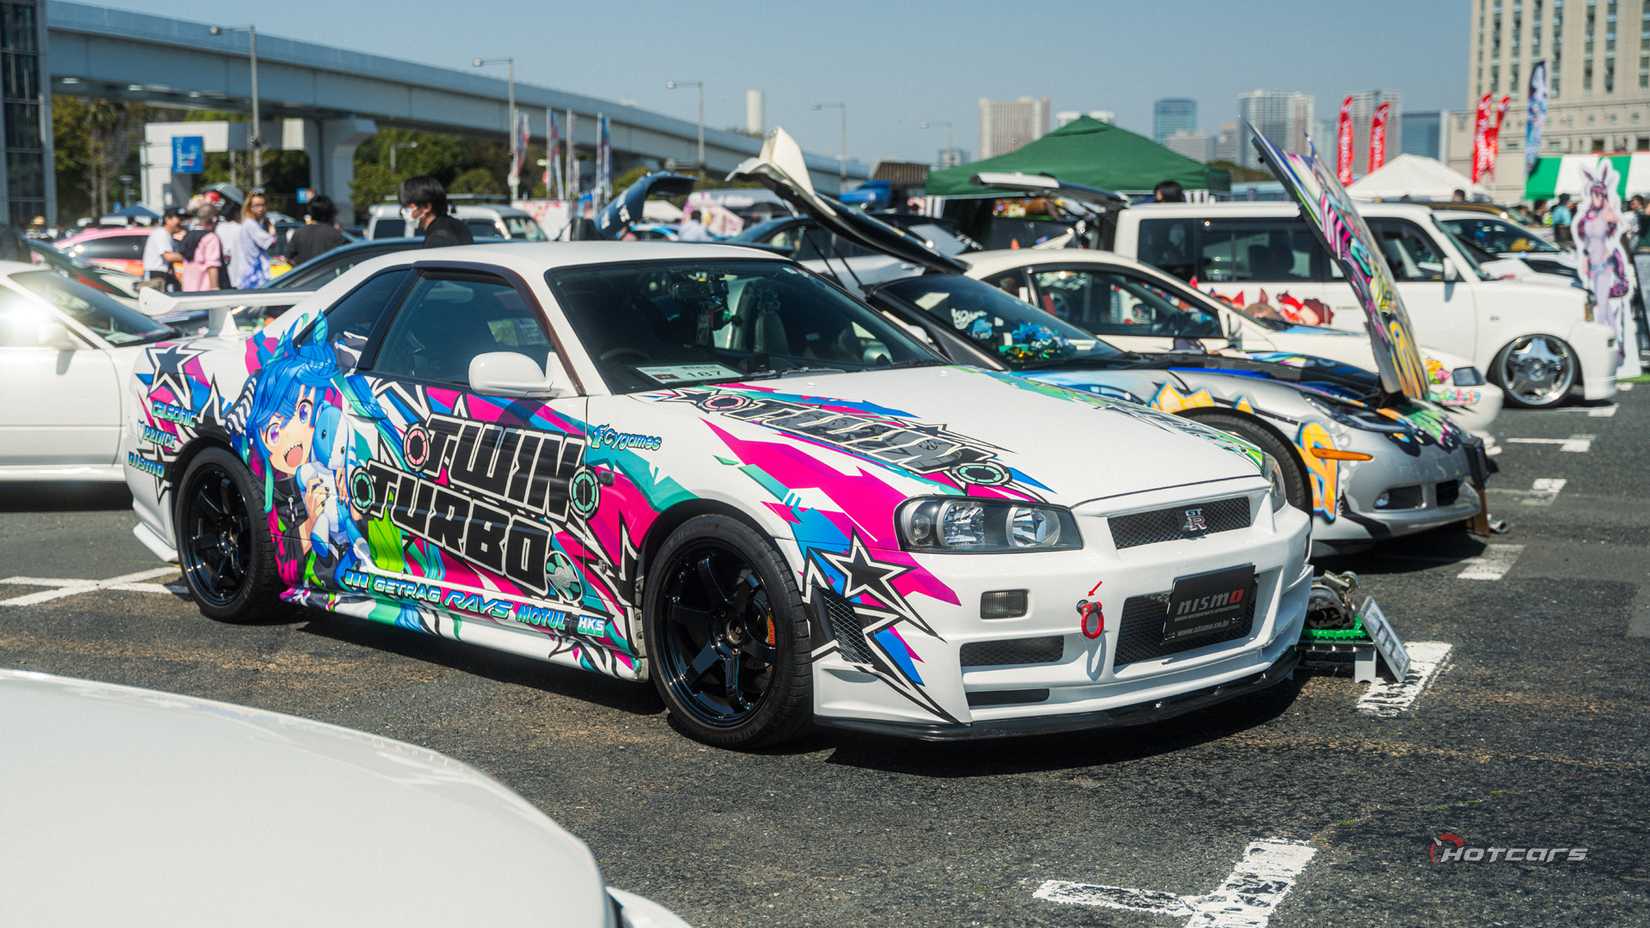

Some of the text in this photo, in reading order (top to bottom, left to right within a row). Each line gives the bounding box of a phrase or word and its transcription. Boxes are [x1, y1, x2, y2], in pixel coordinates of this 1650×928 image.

[425, 413, 587, 522] TWIN
[604, 428, 662, 451] Cygames
[366, 459, 552, 596] TURBO
[374, 577, 606, 637] GETRAG RAYS MOTUL HKS
